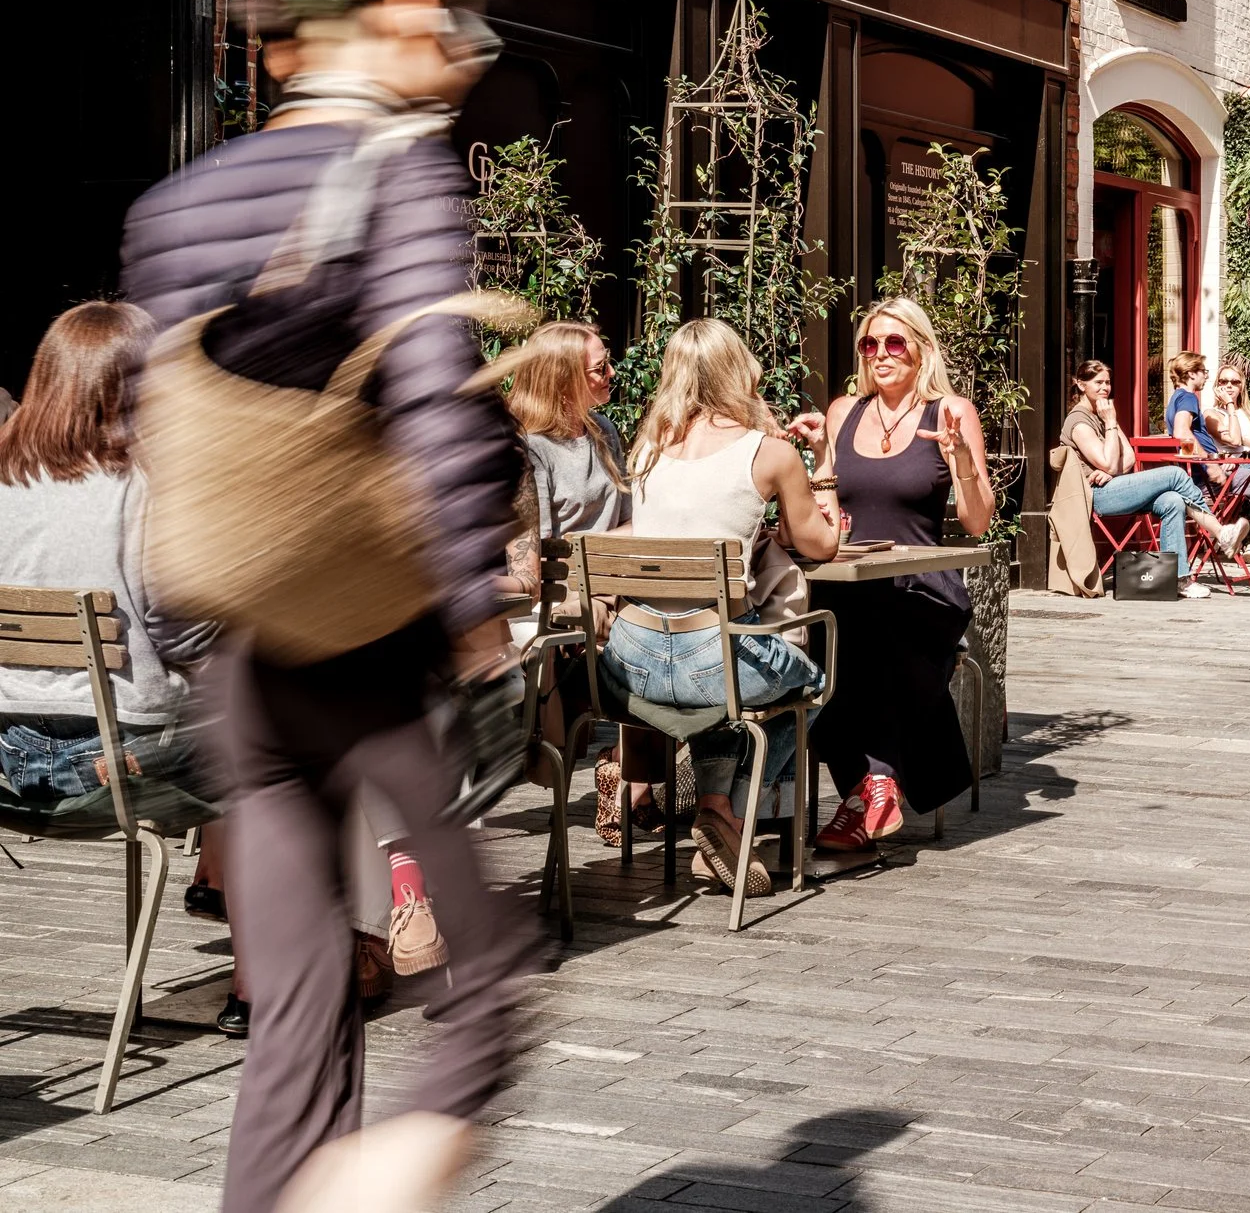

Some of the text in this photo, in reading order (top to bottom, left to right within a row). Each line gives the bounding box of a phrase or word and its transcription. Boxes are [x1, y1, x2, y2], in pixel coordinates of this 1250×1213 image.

[901, 162, 940, 179] THE HISTORY
[1141, 572, 1153, 581] alo
